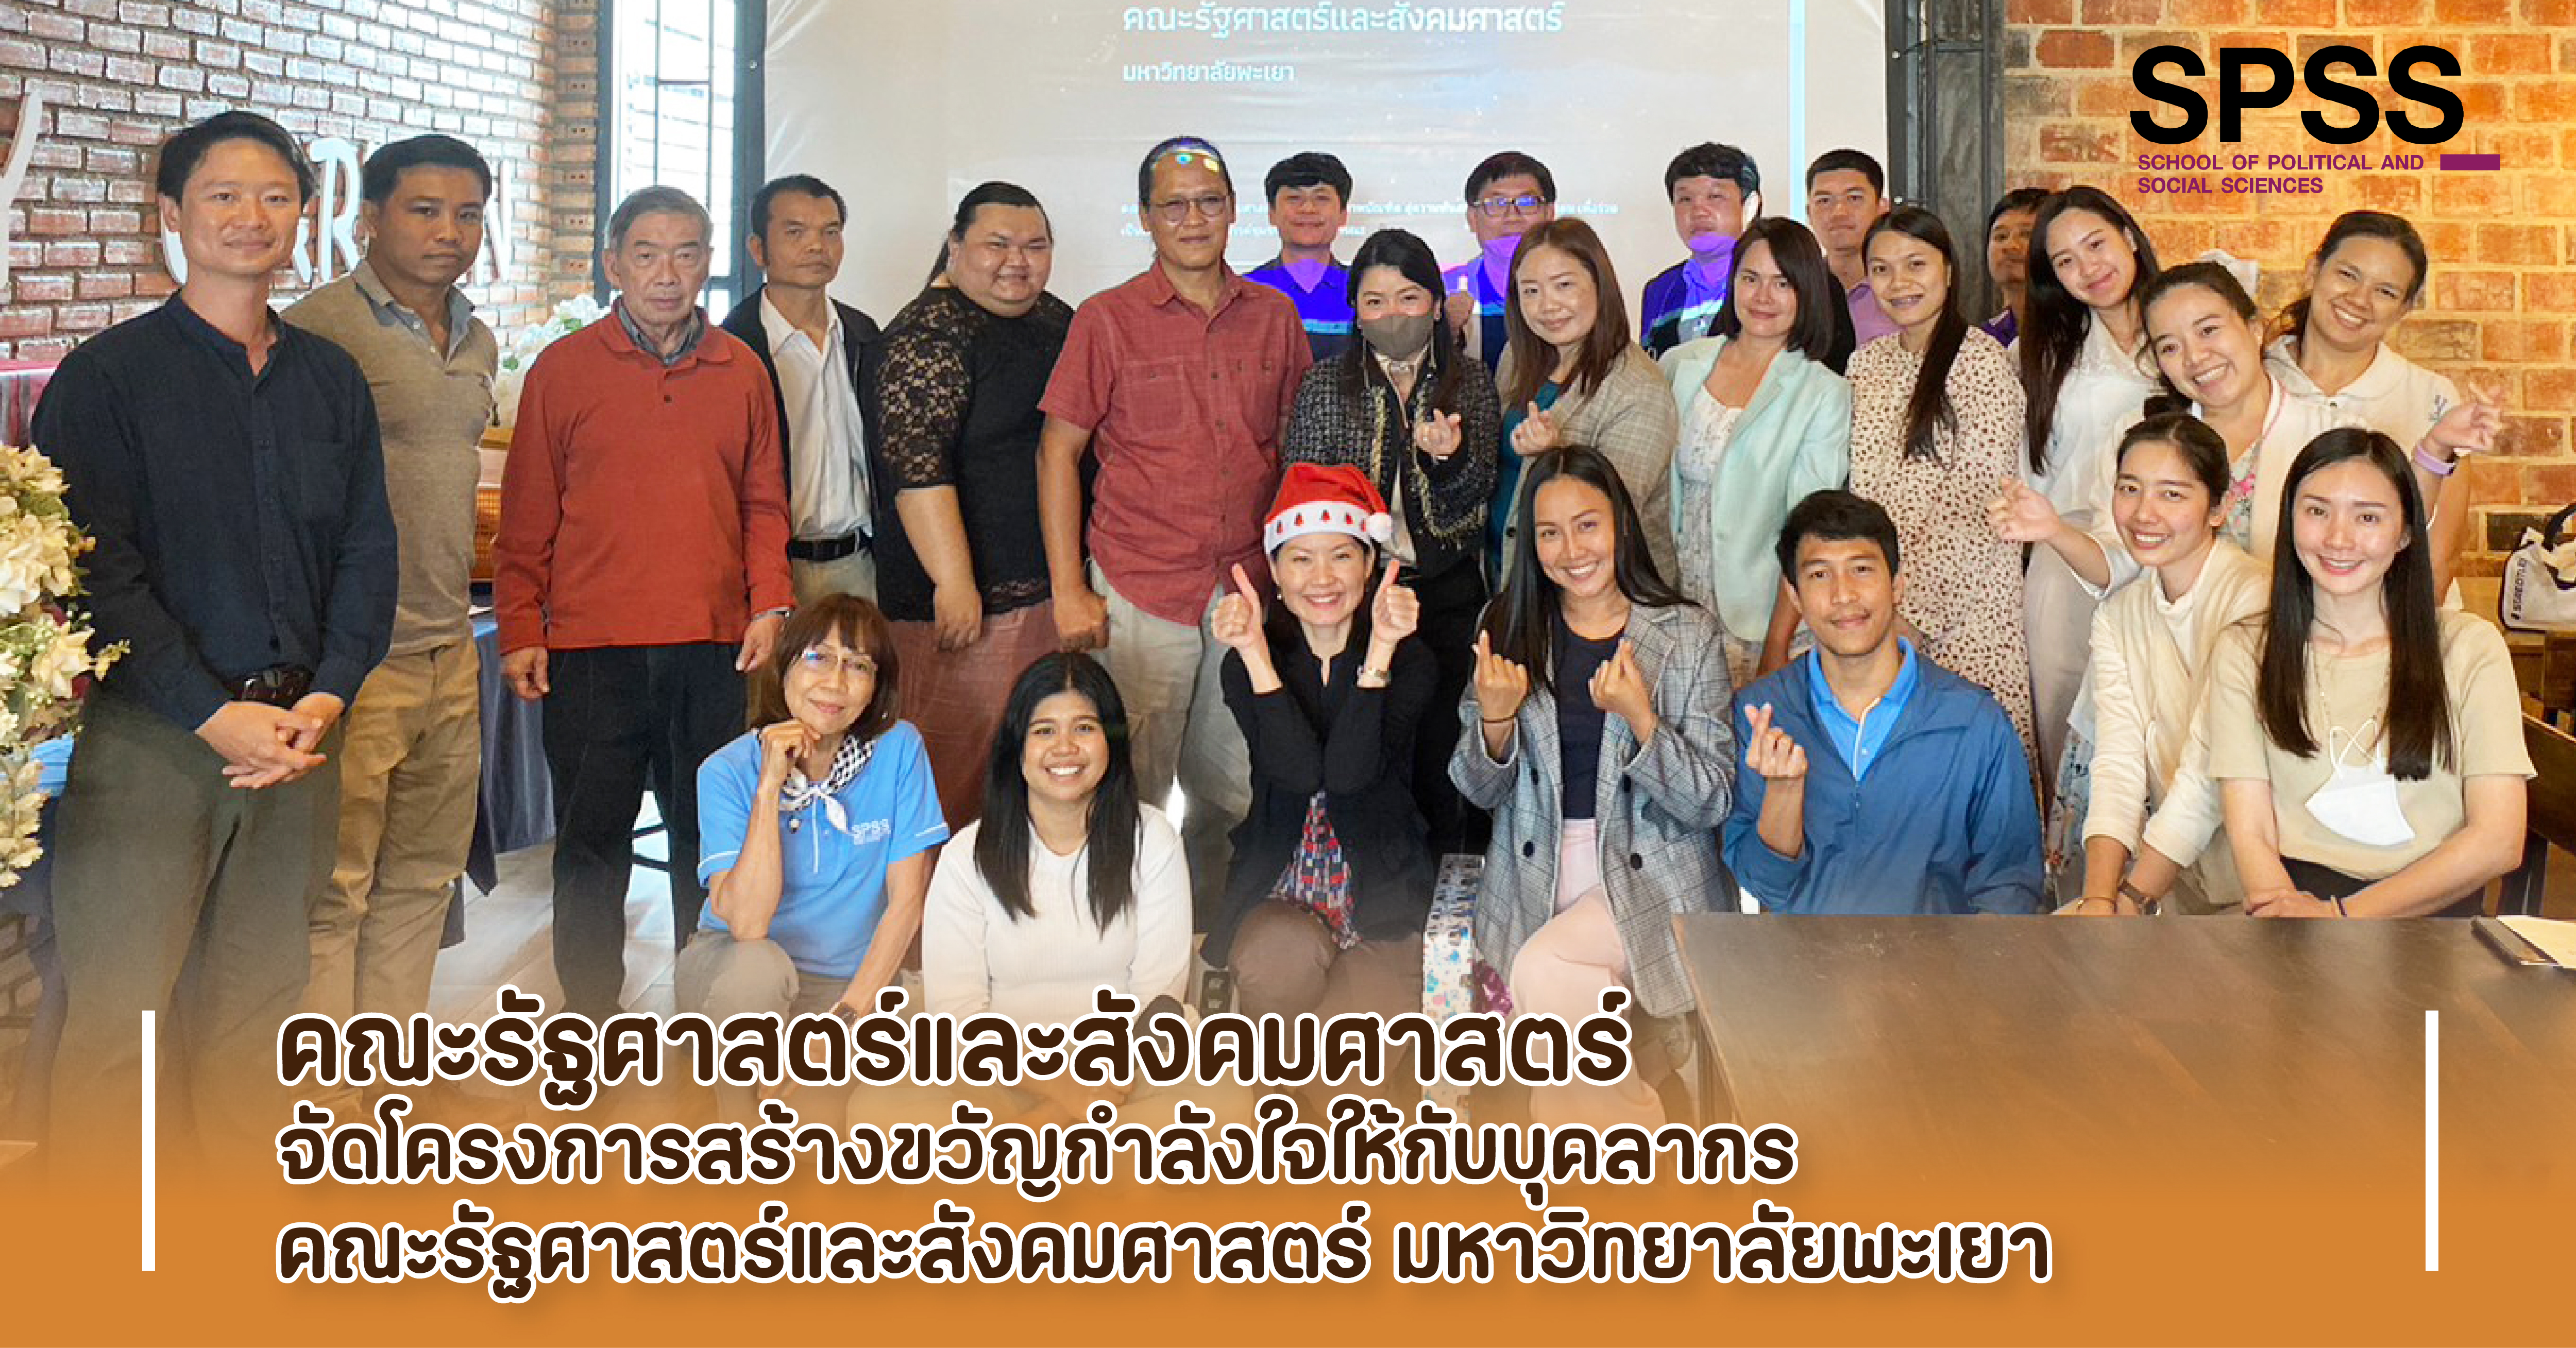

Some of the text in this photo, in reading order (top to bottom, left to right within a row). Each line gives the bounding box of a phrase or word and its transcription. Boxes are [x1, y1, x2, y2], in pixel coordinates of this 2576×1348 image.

[1123, 2, 1565, 39] คณะรัฐศาสตร์และสังคมศาสตร์
[1123, 60, 1295, 81] มหาวิทยาลัยพะเยา
